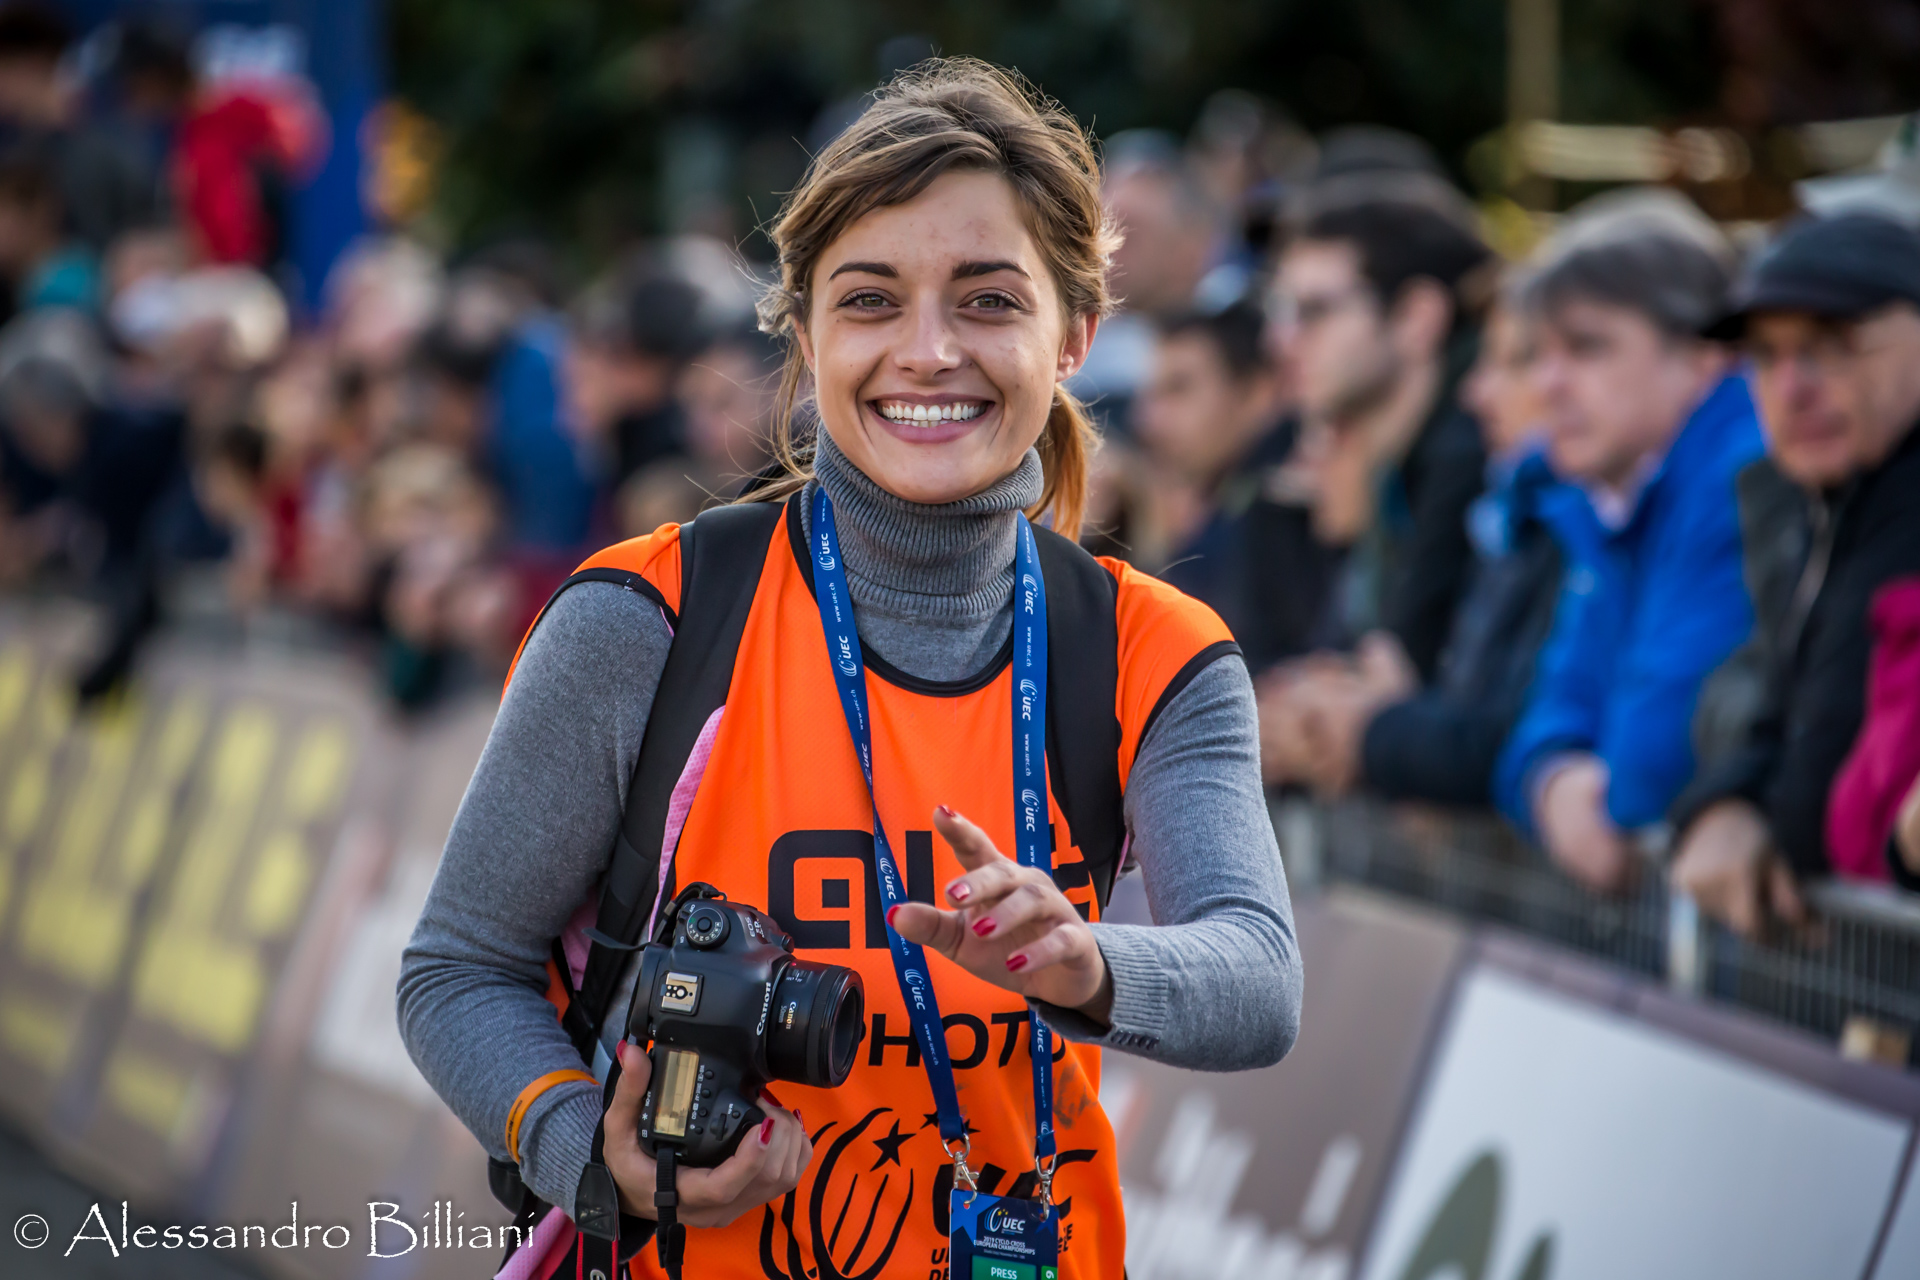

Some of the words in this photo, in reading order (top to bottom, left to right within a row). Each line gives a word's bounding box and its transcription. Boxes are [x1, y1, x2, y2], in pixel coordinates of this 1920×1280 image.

[821, 533, 831, 554] UEC
[829, 582, 841, 622] www.uec.ch
[1025, 590, 1034, 615] UEC
[838, 635, 852, 659] UEC
[1022, 696, 1031, 721] UEC
[1025, 807, 1035, 832] UEC
[884, 875, 897, 900] UEC
[744, 916, 756, 938] EOS
[756, 982, 771, 1036] Canon
[911, 986, 926, 1011] UEC
[786, 1001, 797, 1030] Canon
[924, 1024, 940, 1066] www.uec.ch
[1002, 1217, 1026, 1231] UEC
[973, 1239, 998, 1249] EUROPEAN
[998, 1243, 1036, 1255] CHAMPIONSHIPS
[990, 1267, 1018, 1280] PRESS
